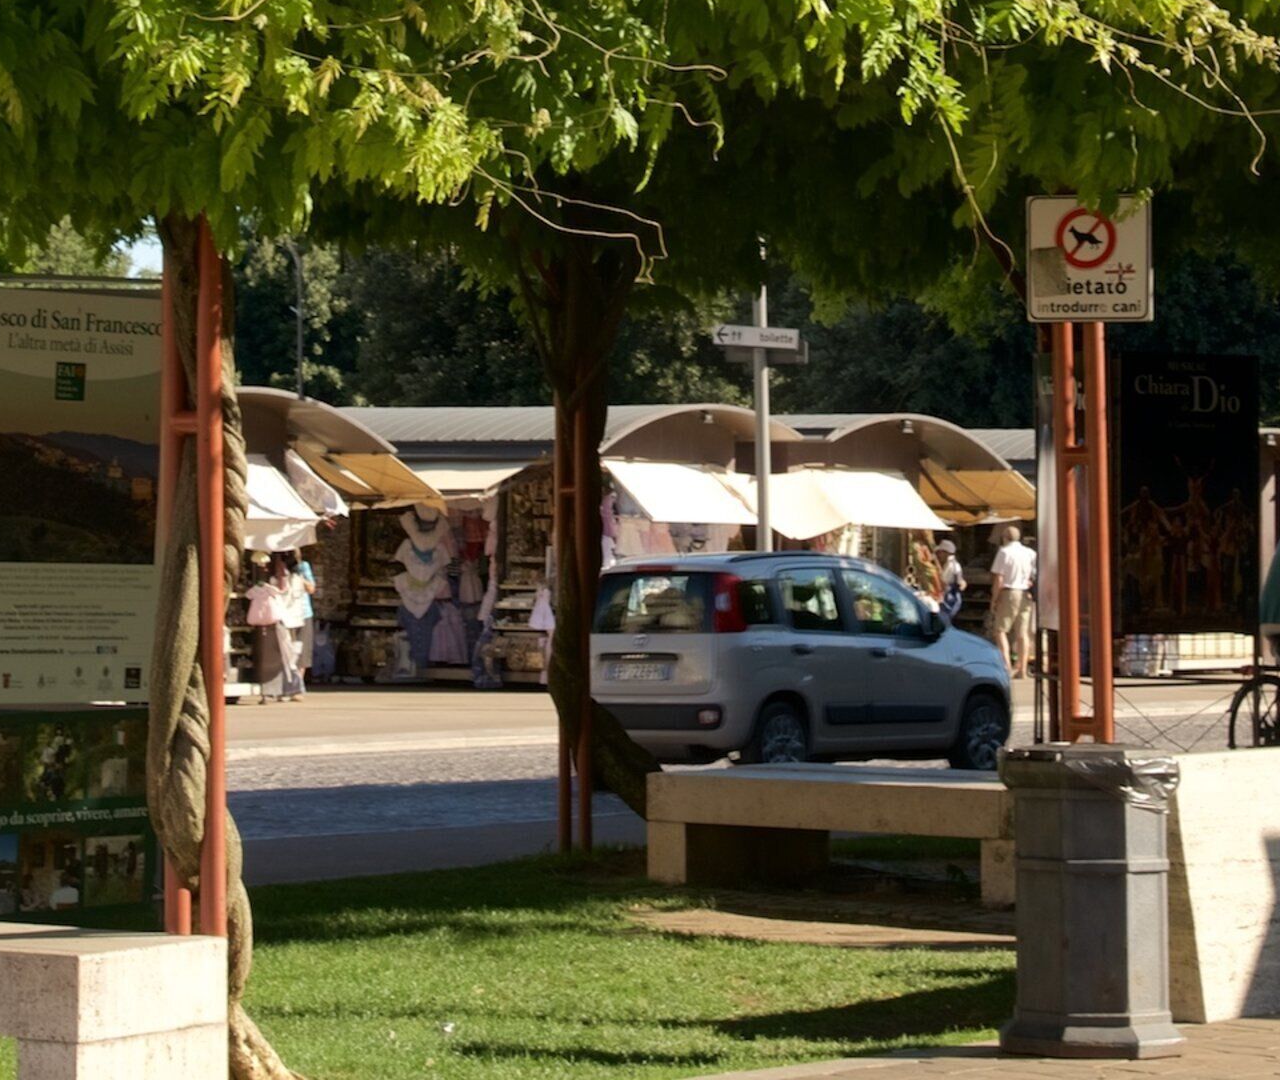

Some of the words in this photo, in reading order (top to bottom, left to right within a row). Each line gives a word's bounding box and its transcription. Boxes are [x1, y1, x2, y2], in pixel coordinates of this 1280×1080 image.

[1064, 277, 1127, 295] ietato
[1113, 300, 1142, 313] cani
[31, 308, 48, 329] di
[51, 309, 81, 332] San
[8, 332, 47, 350] L'altra
[49, 336, 81, 353] metà
[84, 336, 98, 353] di
[100, 339, 134, 356] Assisi
[760, 332, 793, 344] toilette
[1134, 374, 1190, 395] Chiara
[1189, 375, 1241, 413] Dio
[10, 810, 24, 826] da
[26, 809, 76, 828] scoprire,
[113, 806, 148, 819] amare
